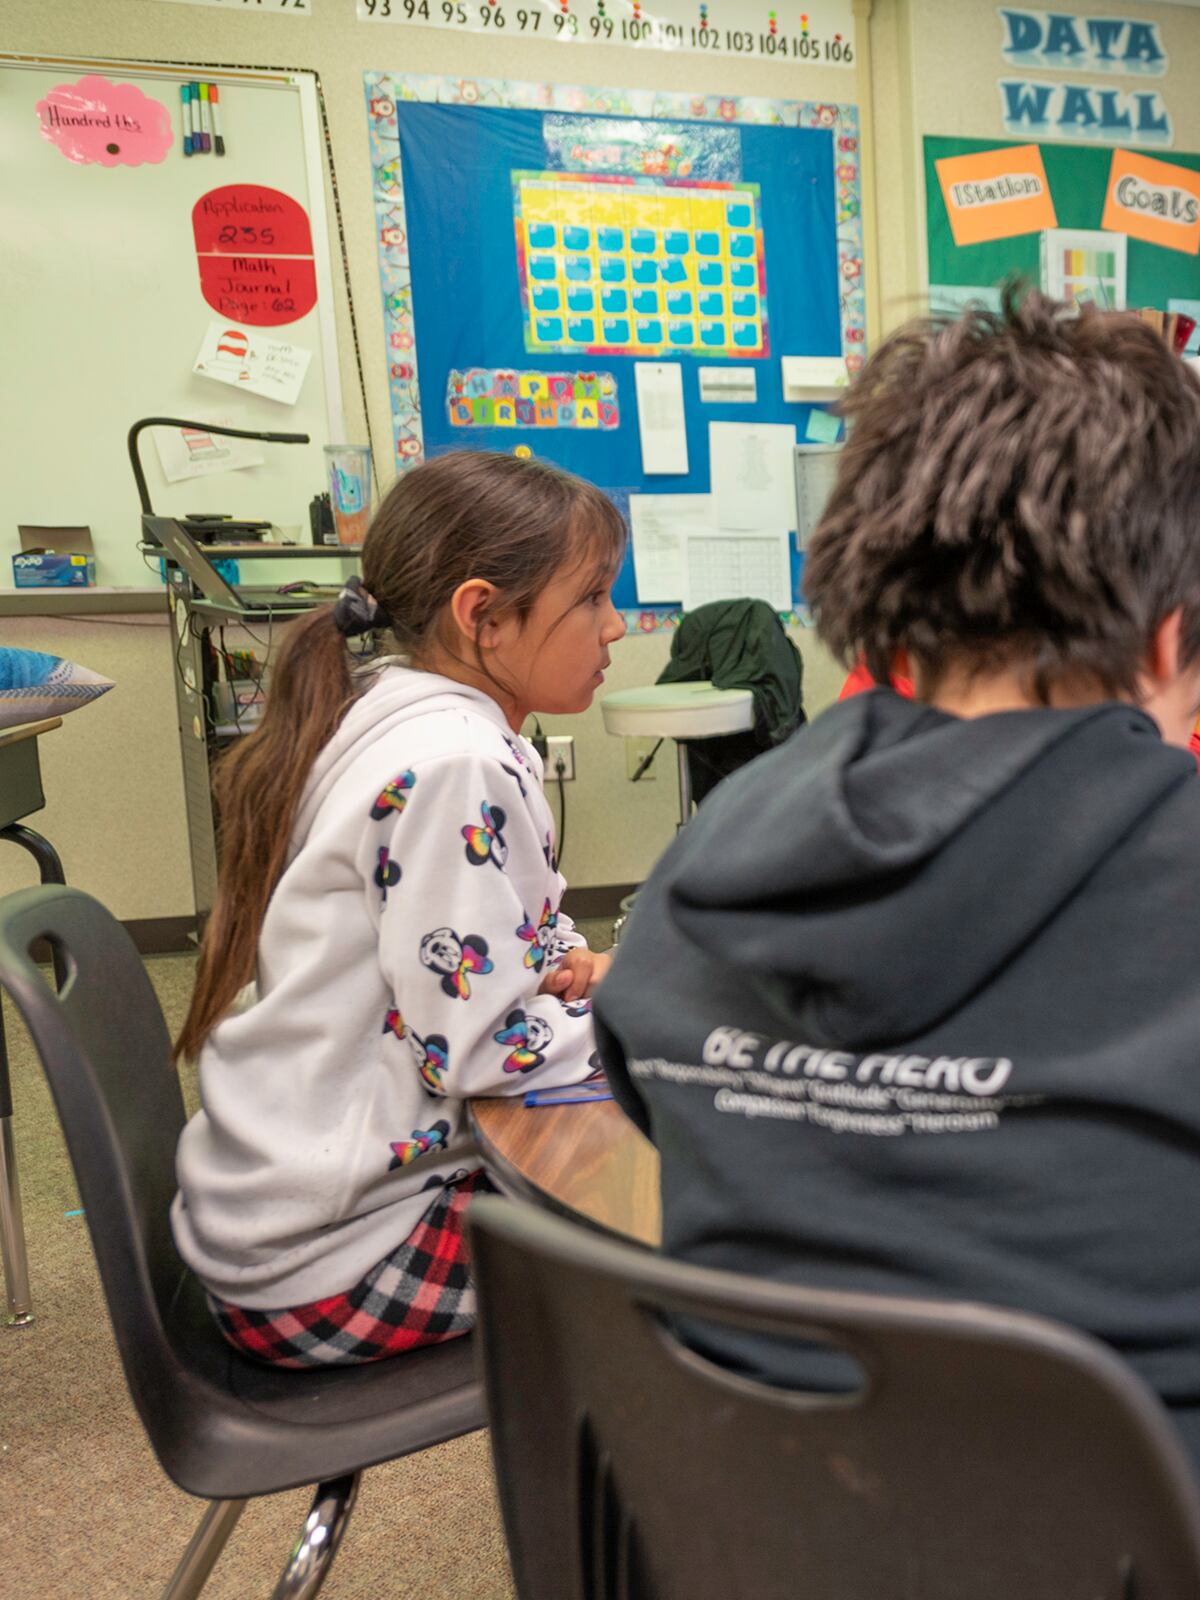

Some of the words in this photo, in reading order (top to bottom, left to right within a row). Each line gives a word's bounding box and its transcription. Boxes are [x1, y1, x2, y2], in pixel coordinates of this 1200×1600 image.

[368, 0, 392, 17] 93
[403, 0, 431, 20] 94
[442, 1, 468, 25] 95
[479, 6, 506, 28] 96
[516, 9, 541, 31] 97
[589, 16, 614, 39] 99
[621, 18, 652, 41] 100
[691, 27, 720, 50] 102
[726, 31, 754, 53] 103
[759, 33, 788, 56] 104
[793, 37, 820, 60] 105
[825, 40, 853, 63] 106
[1000, 10, 1165, 63] DATA
[1000, 82, 1170, 134] WALL
[1116, 176, 1199, 224] Goals
[218, 225, 276, 245] 235
[232, 257, 277, 275] Math
[218, 277, 291, 294] Journal
[472, 376, 595, 397] HAPPY
[456, 404, 613, 421] BIRTHDAY
